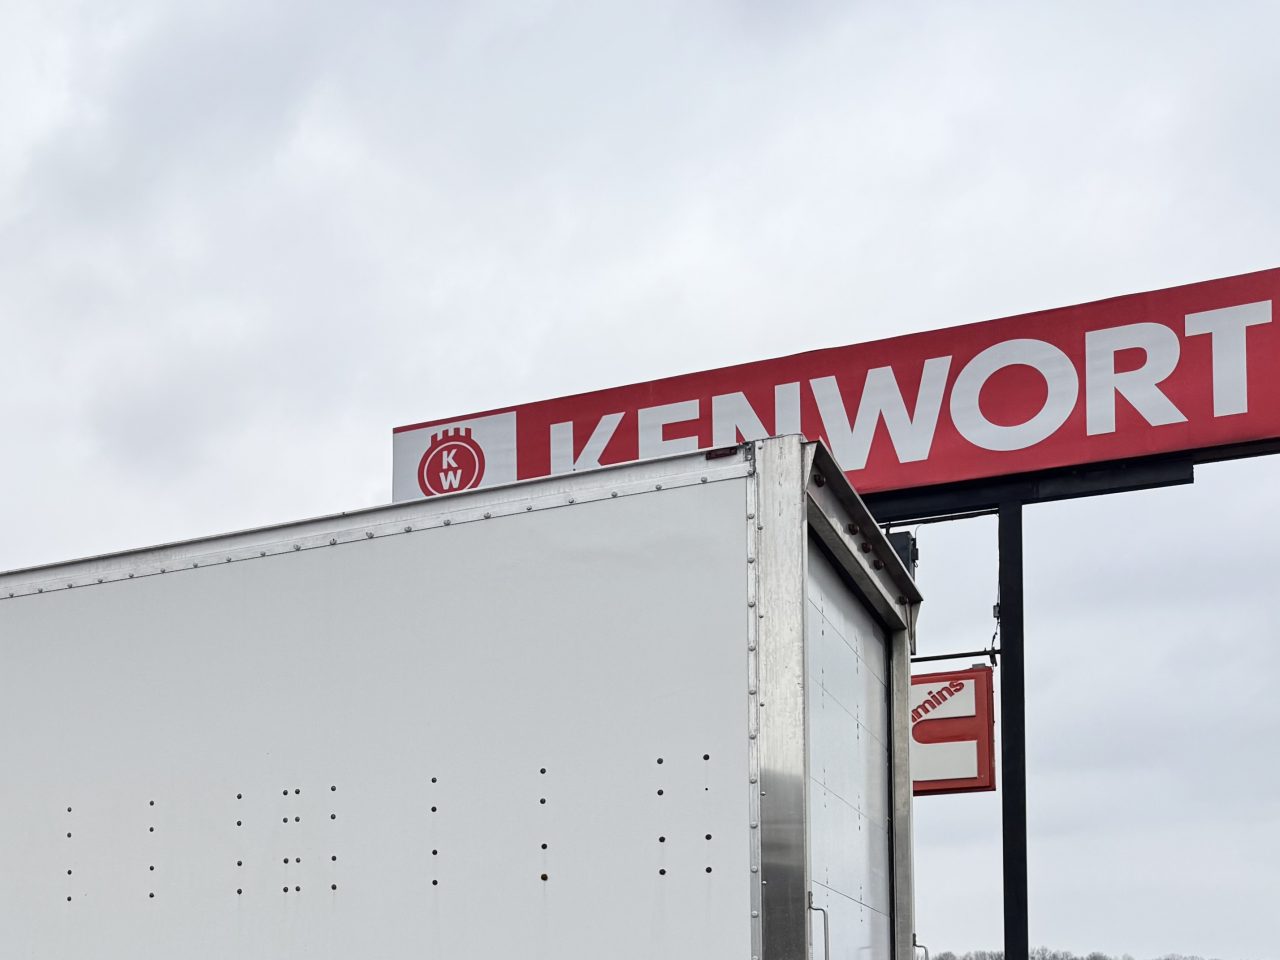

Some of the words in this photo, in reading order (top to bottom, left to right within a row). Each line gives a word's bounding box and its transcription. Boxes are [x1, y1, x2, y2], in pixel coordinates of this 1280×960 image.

[442, 448, 459, 470] K
[439, 469, 463, 491] W
[911, 680, 965, 723] mins
